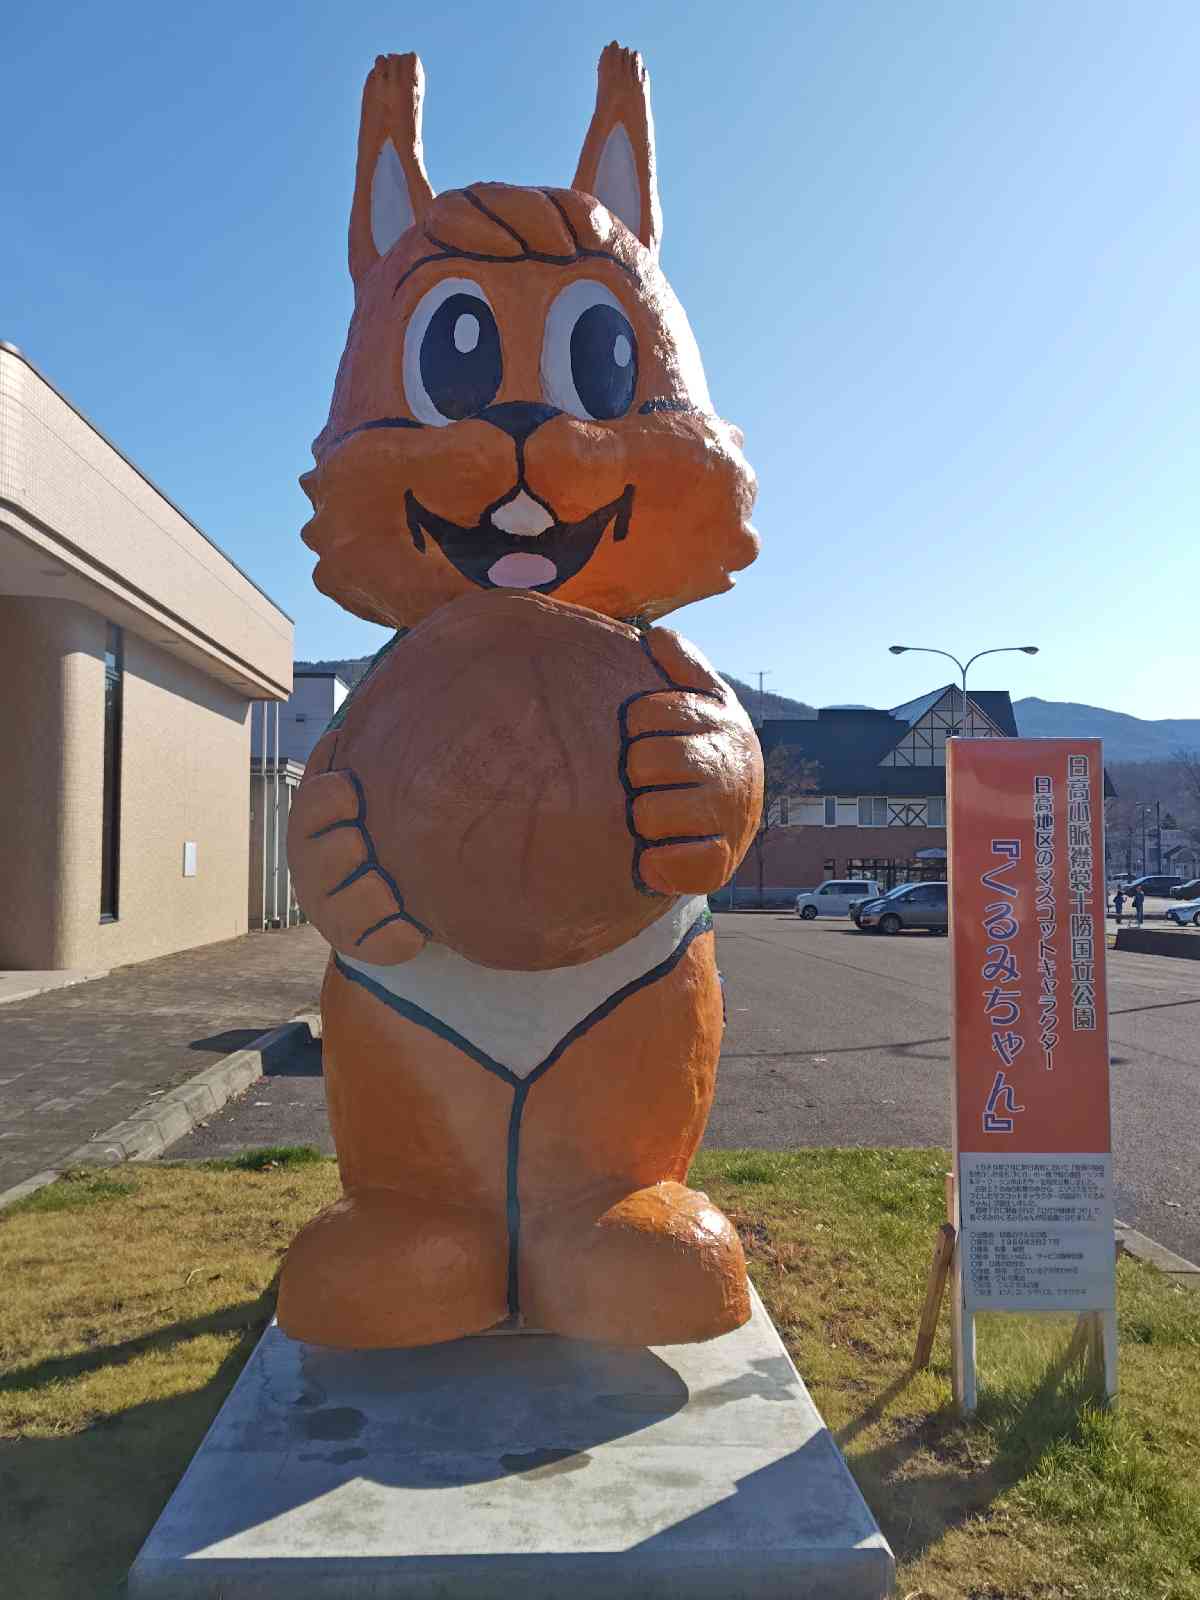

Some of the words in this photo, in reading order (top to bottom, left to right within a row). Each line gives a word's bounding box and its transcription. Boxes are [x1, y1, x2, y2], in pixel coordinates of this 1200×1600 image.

[981, 839, 1024, 1132] 『くるみちゃん』
[1034, 776, 1058, 1069] 日高地区のマスコットキャラクター
[1068, 755, 1096, 1030] 日高山脈襟裳十勝国立公園
